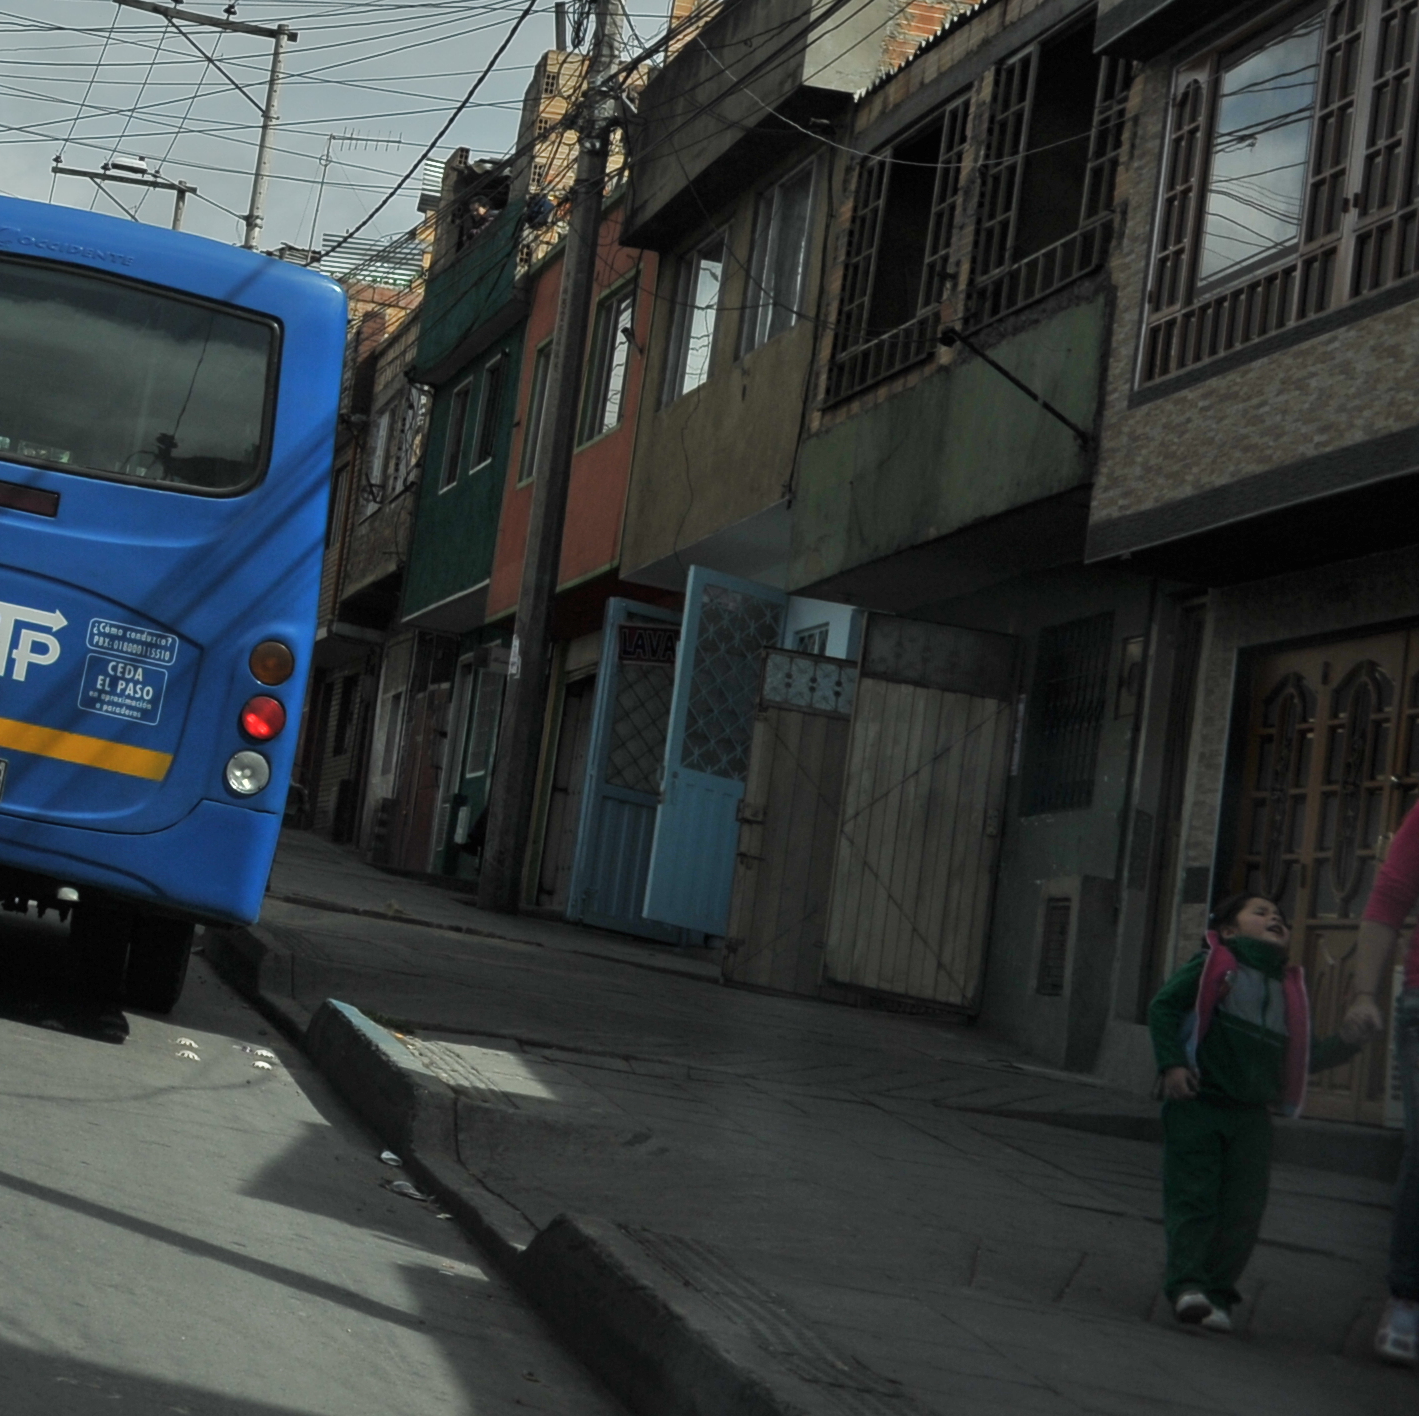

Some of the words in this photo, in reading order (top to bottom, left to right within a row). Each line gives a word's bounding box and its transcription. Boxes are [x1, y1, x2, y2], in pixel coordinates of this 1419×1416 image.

[16, 233, 135, 267] OCCIDENTE
[93, 623, 123, 636] ¿Cómo
[126, 631, 173, 647] conduzco?
[93, 635, 112, 646] PBX:
[107, 661, 143, 682] CEDA
[96, 675, 111, 691] EL
[116, 680, 153, 700] PASO
[101, 693, 152, 710] aproximación
[102, 703, 142, 718] paraderos
